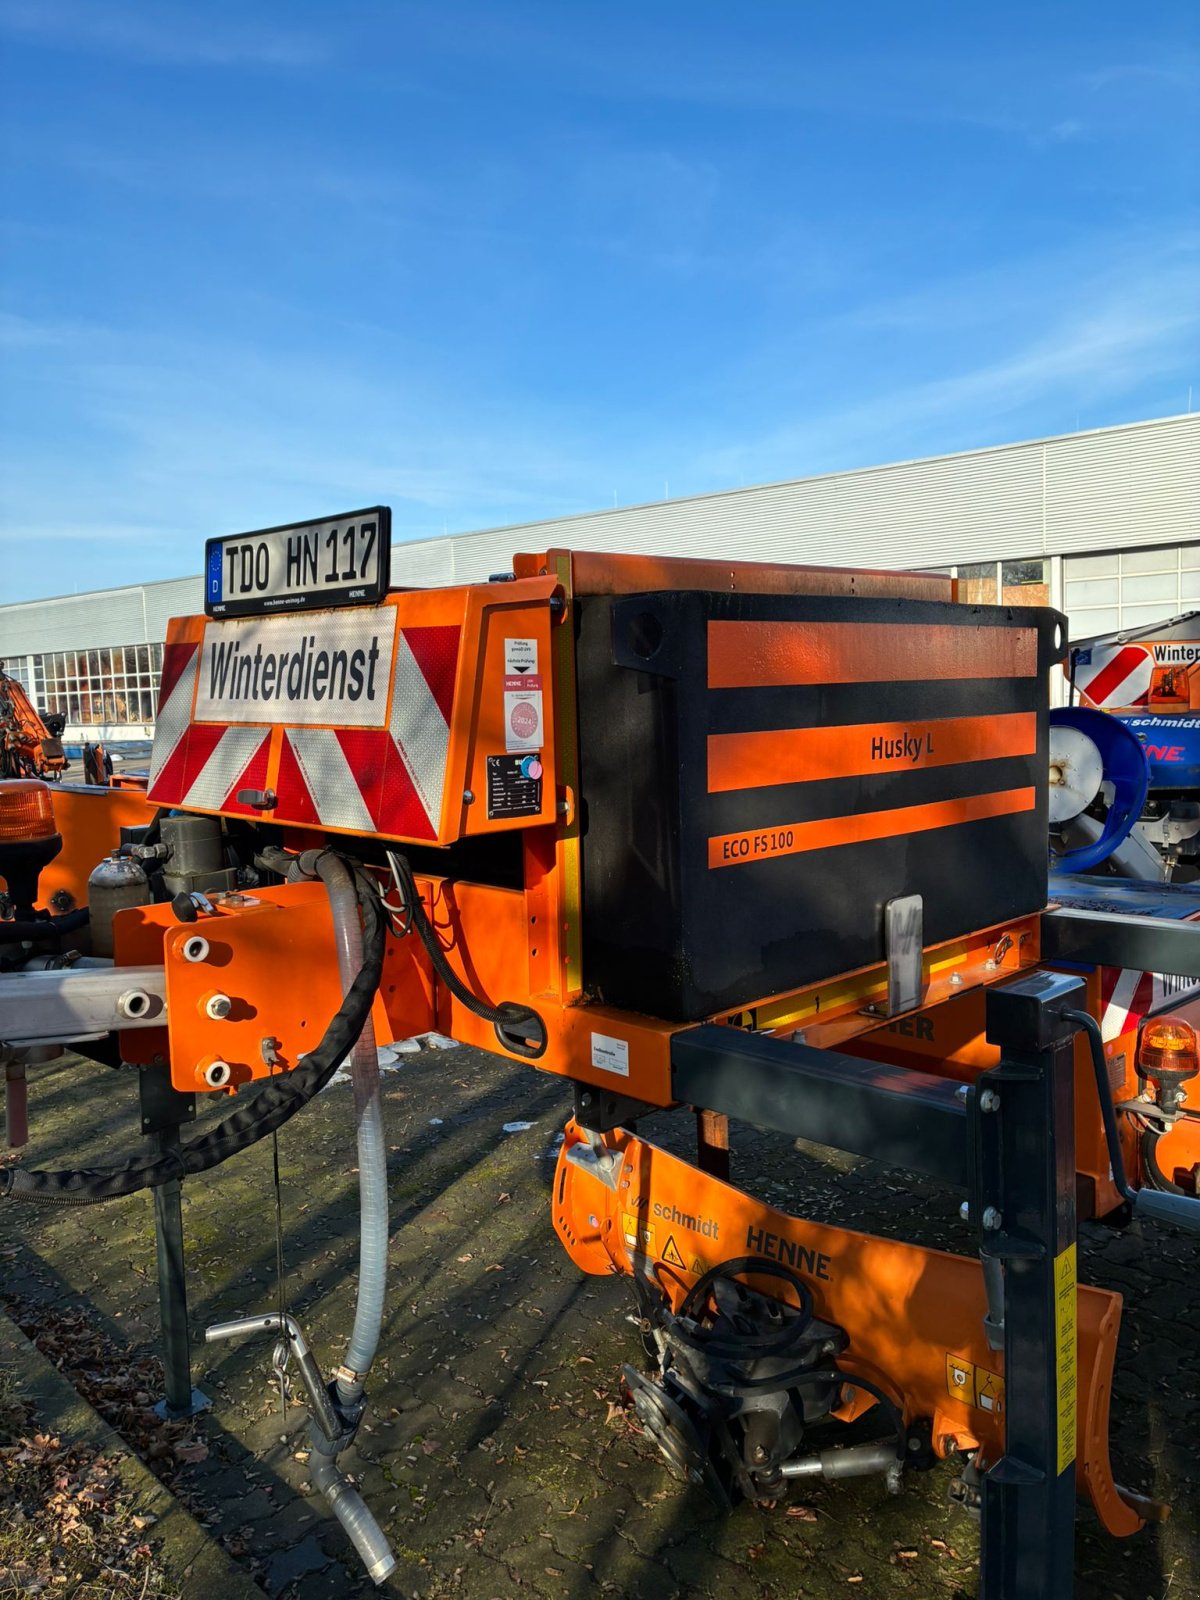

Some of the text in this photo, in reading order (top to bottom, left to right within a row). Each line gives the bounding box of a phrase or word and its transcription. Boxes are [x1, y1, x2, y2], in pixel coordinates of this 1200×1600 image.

[226, 522, 377, 594] TDO HN 117
[212, 579, 219, 593] D
[349, 589, 366, 598] HENNE
[210, 635, 380, 701] Winterdienst
[871, 732, 934, 763] Husky L
[723, 831, 794, 859] ECO FS 100
[653, 1202, 720, 1240] schmidt
[746, 1225, 832, 1282] HENNE
